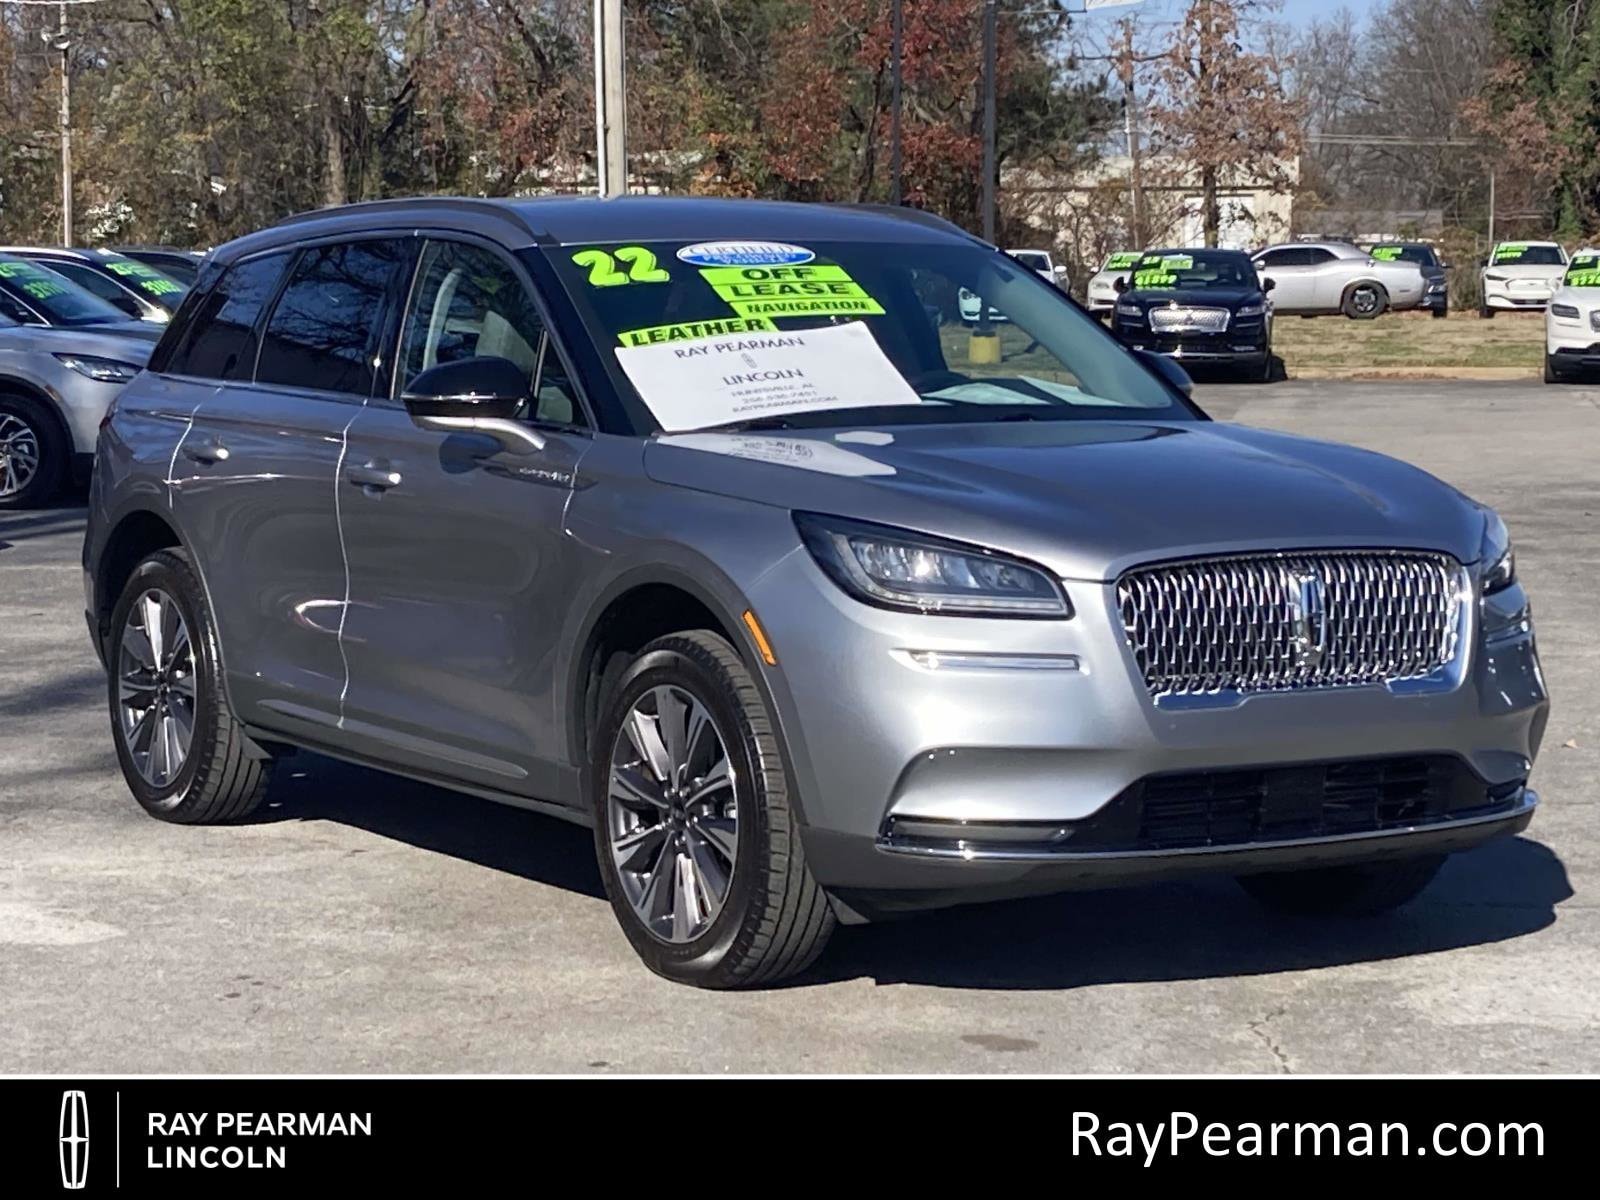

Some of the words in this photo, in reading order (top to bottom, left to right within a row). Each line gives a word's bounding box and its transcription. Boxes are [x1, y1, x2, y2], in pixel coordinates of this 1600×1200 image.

[572, 247, 670, 287] 22
[741, 267, 817, 281] OFF
[730, 282, 850, 297] LEASE
[746, 300, 867, 313] NAVIGATION
[630, 319, 766, 346] LEATHER
[674, 345, 713, 359] RAY
[715, 336, 806, 354] PEARMAN
[722, 367, 805, 386] LINCOLN
